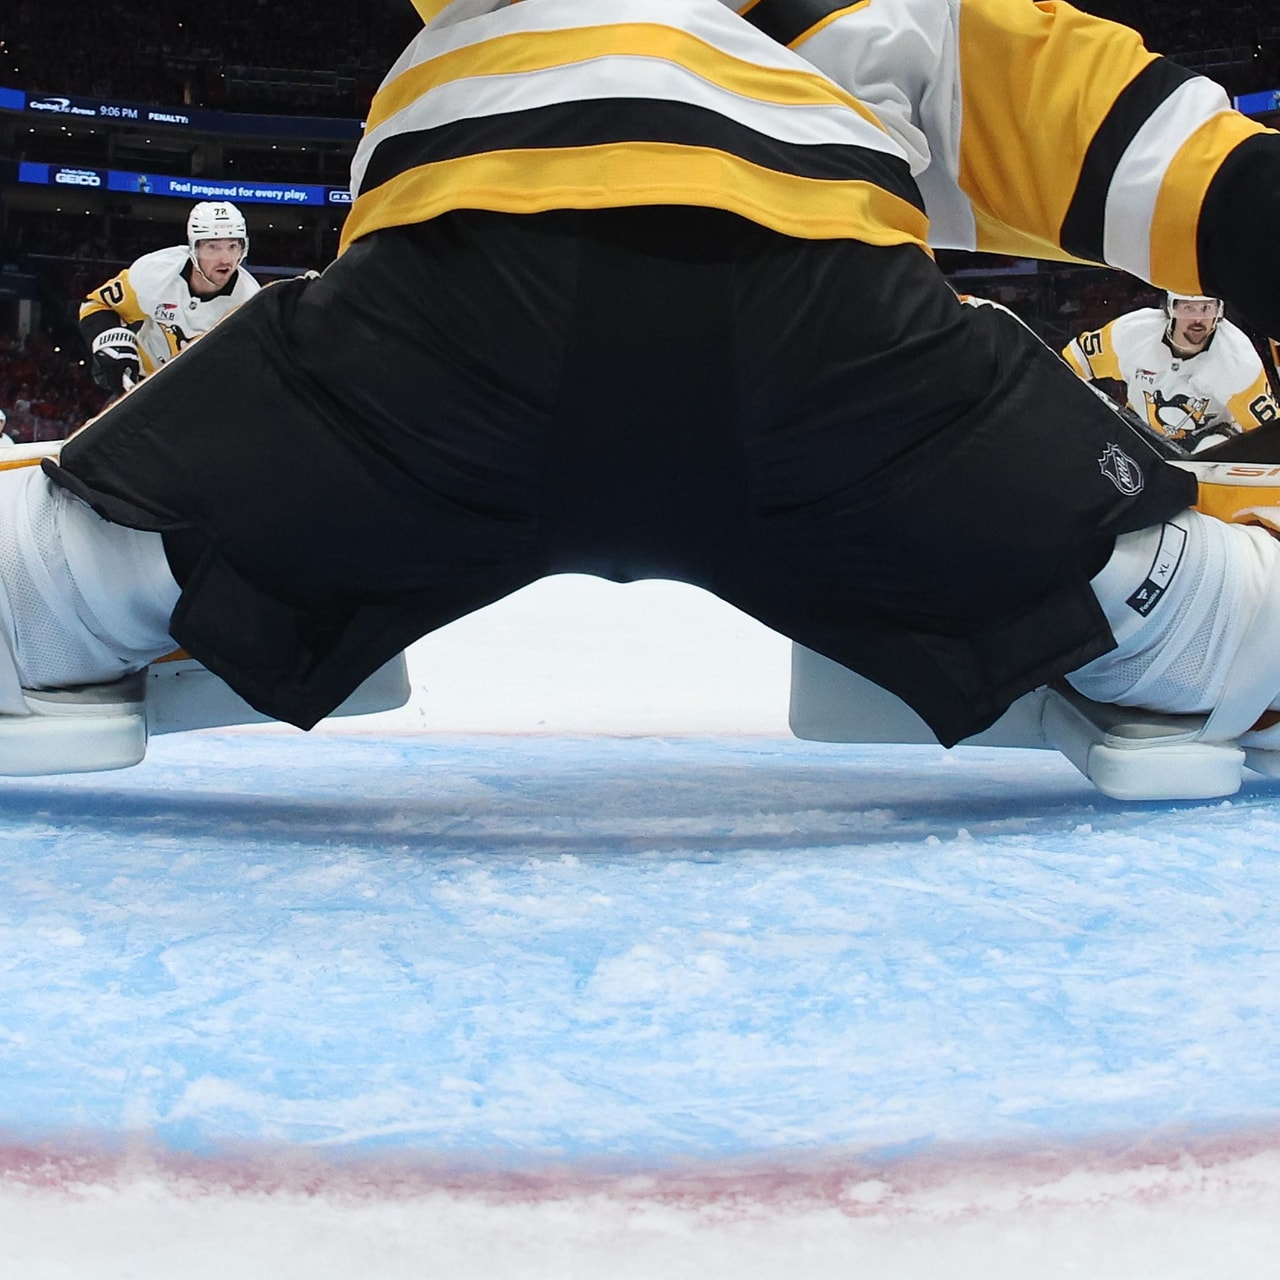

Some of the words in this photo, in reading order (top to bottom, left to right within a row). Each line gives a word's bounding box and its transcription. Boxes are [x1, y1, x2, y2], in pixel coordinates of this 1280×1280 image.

[99, 105, 120, 118] 9:06
[122, 107, 139, 119] PM
[55, 173, 101, 187] GEICO
[170, 181, 188, 193] Feel
[189, 183, 238, 198] prepared
[238, 185, 255, 196] for
[255, 188, 284, 200] every
[284, 188, 309, 201] play.
[98, 332, 138, 347] WARR
[1157, 563, 1170, 576] XL
